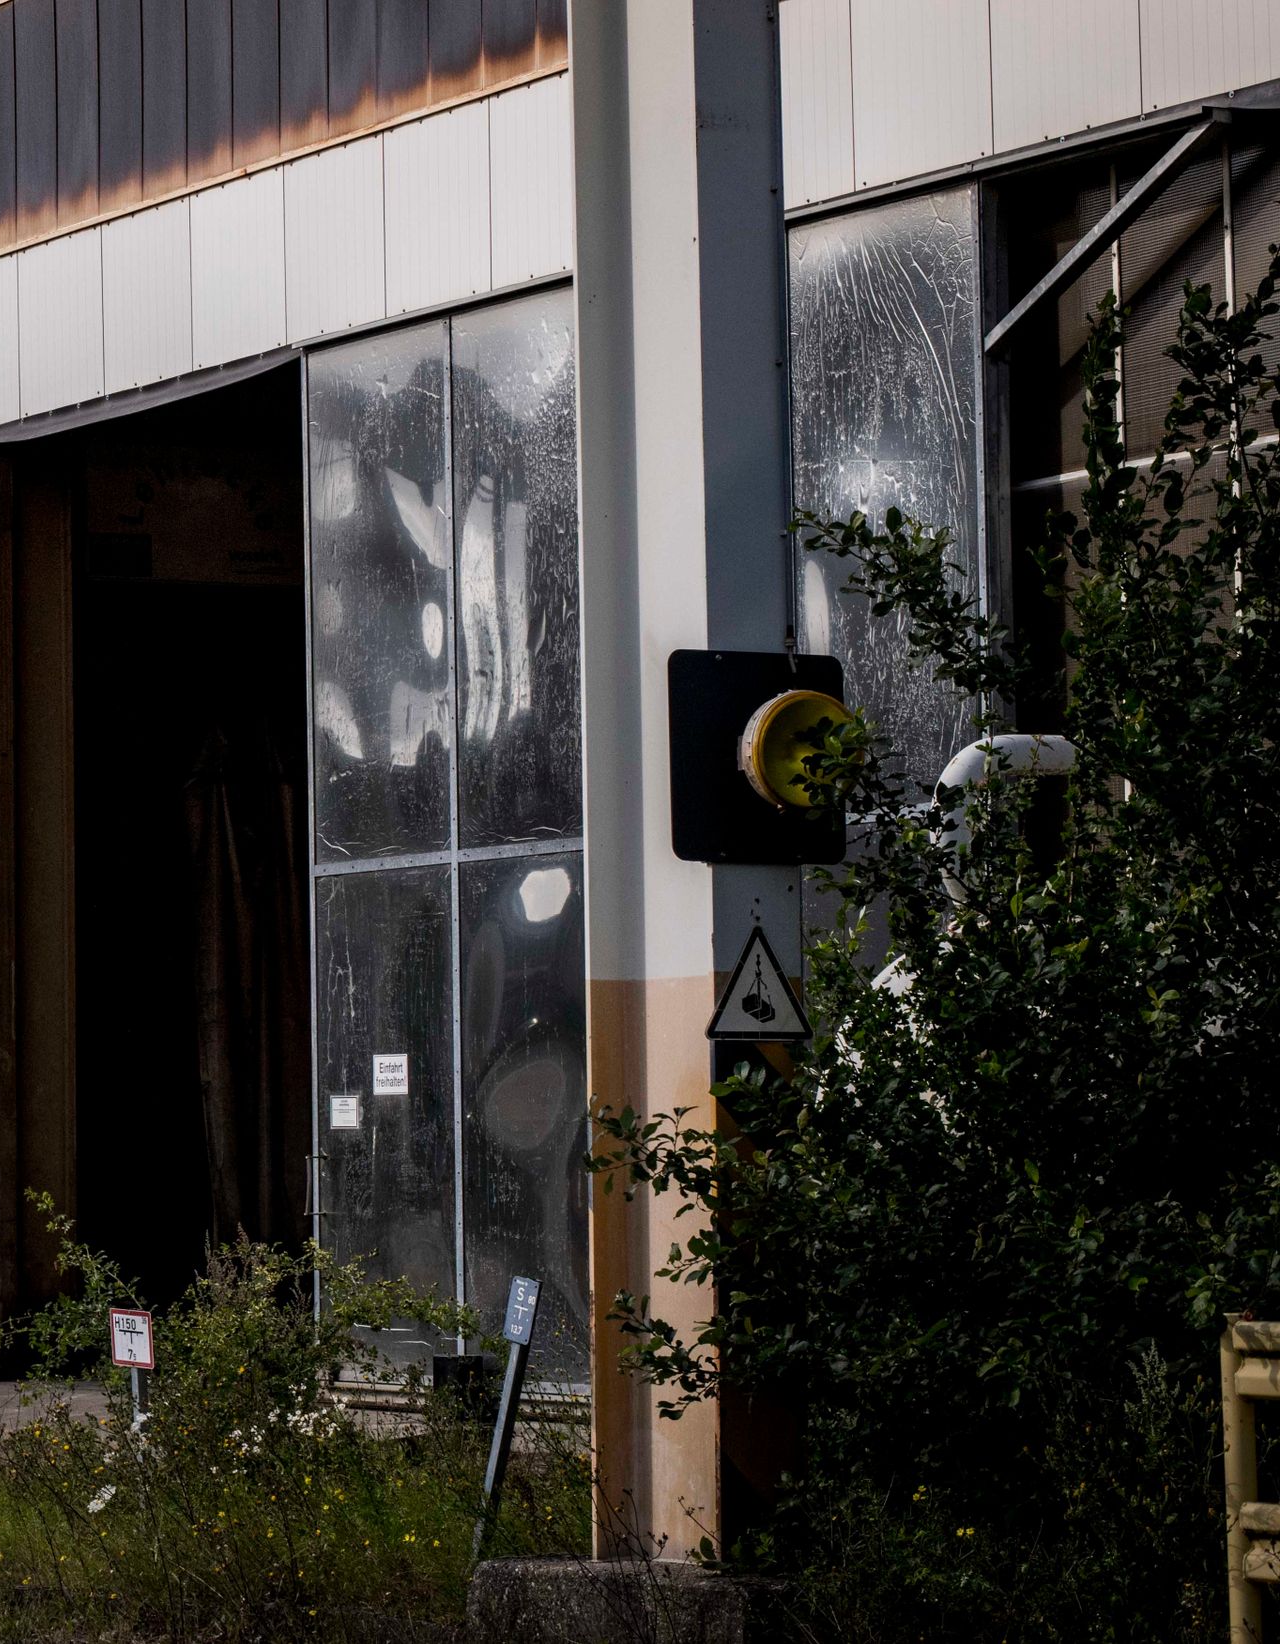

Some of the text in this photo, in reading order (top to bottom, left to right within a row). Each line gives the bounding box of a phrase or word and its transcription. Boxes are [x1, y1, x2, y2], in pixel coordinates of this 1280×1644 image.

[379, 1062, 404, 1074] Einfahrt
[376, 1077, 407, 1088] freihalten!
[517, 1287, 525, 1302] S
[114, 1316, 137, 1331] H150
